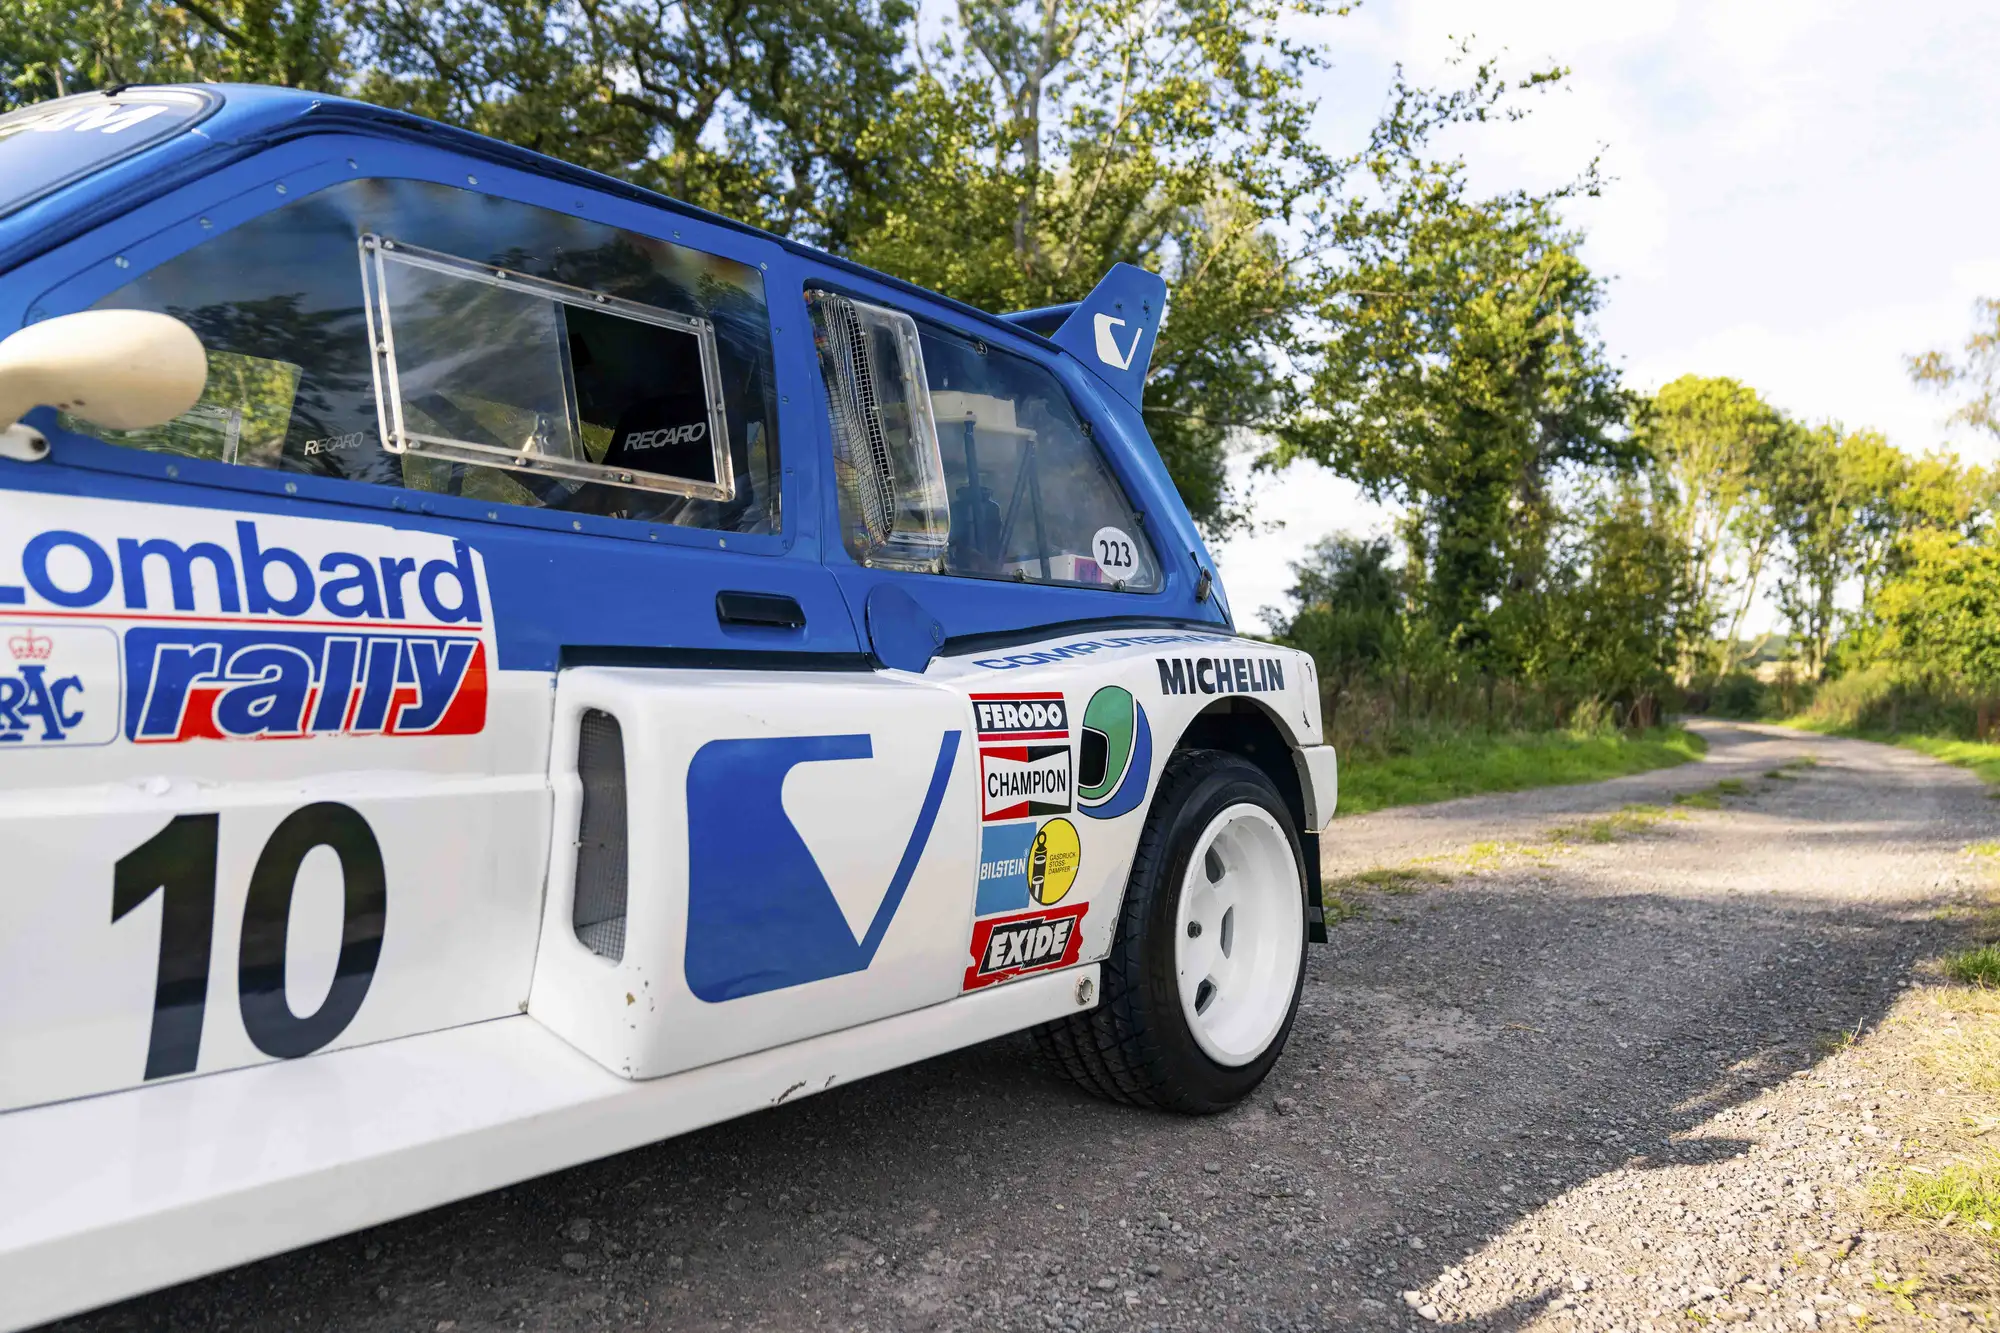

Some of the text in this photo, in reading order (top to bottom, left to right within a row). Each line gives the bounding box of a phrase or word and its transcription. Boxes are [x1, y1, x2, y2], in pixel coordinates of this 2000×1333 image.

[304, 431, 364, 456] RECARO
[623, 422, 706, 451] RECARO
[1099, 540, 1132, 567] 223
[0, 520, 484, 624] ombard
[134, 636, 480, 742] rally
[1155, 657, 1285, 695] MICHELIN
[977, 703, 1063, 729] FERODO
[987, 769, 1067, 799] CHAMPION
[980, 857, 1027, 880] BILSTEIN
[111, 801, 388, 1082] 10
[987, 920, 1070, 969] EXIDE
